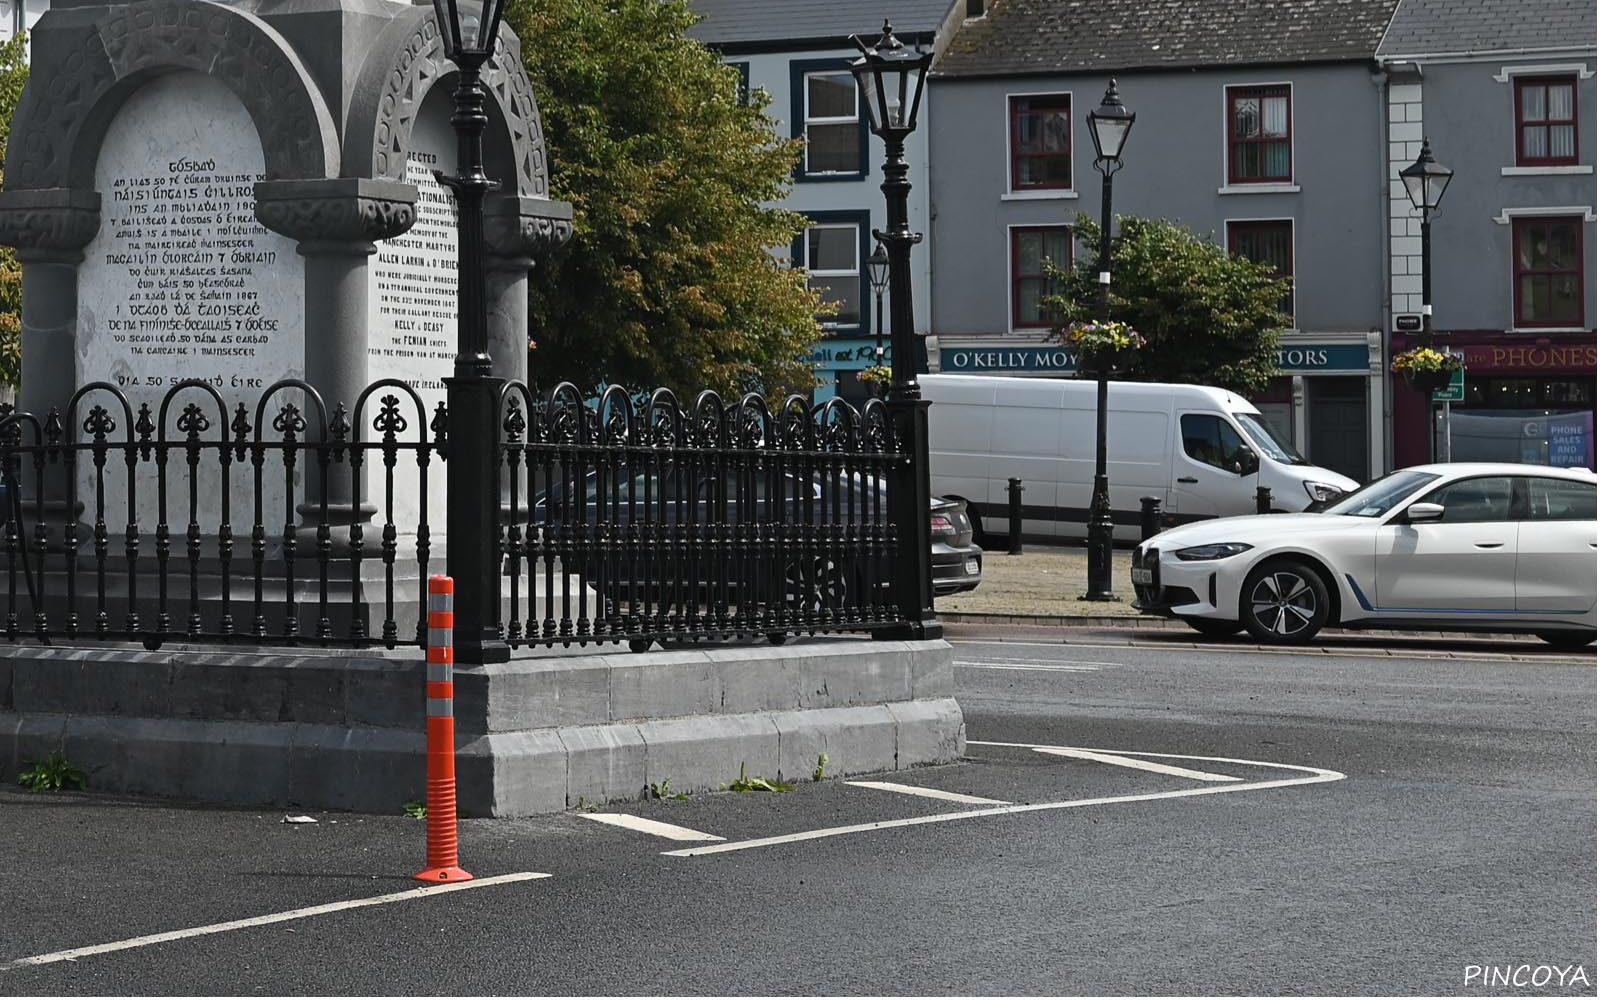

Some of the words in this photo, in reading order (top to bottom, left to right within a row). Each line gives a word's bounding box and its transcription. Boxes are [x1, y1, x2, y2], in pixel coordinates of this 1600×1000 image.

[407, 151, 436, 164] RECTED
[418, 192, 456, 206] ATIONALIST
[426, 242, 455, 252] MARTYRS
[379, 253, 399, 264] ALLEN
[402, 256, 424, 267] LARKIN
[434, 276, 457, 284] MURDERE
[395, 320, 415, 331] KELLY
[424, 322, 444, 333] DEASY
[404, 335, 426, 346] FENIAN
[953, 352, 1028, 368] O'KELLY
[1035, 352, 1079, 368] MOY
[1277, 350, 1327, 365] TORS
[1493, 348, 1596, 367] PHONES
[1551, 426, 1582, 435] PHONE
[1553, 435, 1581, 444] SALES
[1557, 446, 1576, 454] AND
[1551, 455, 1584, 464] REPAIR
